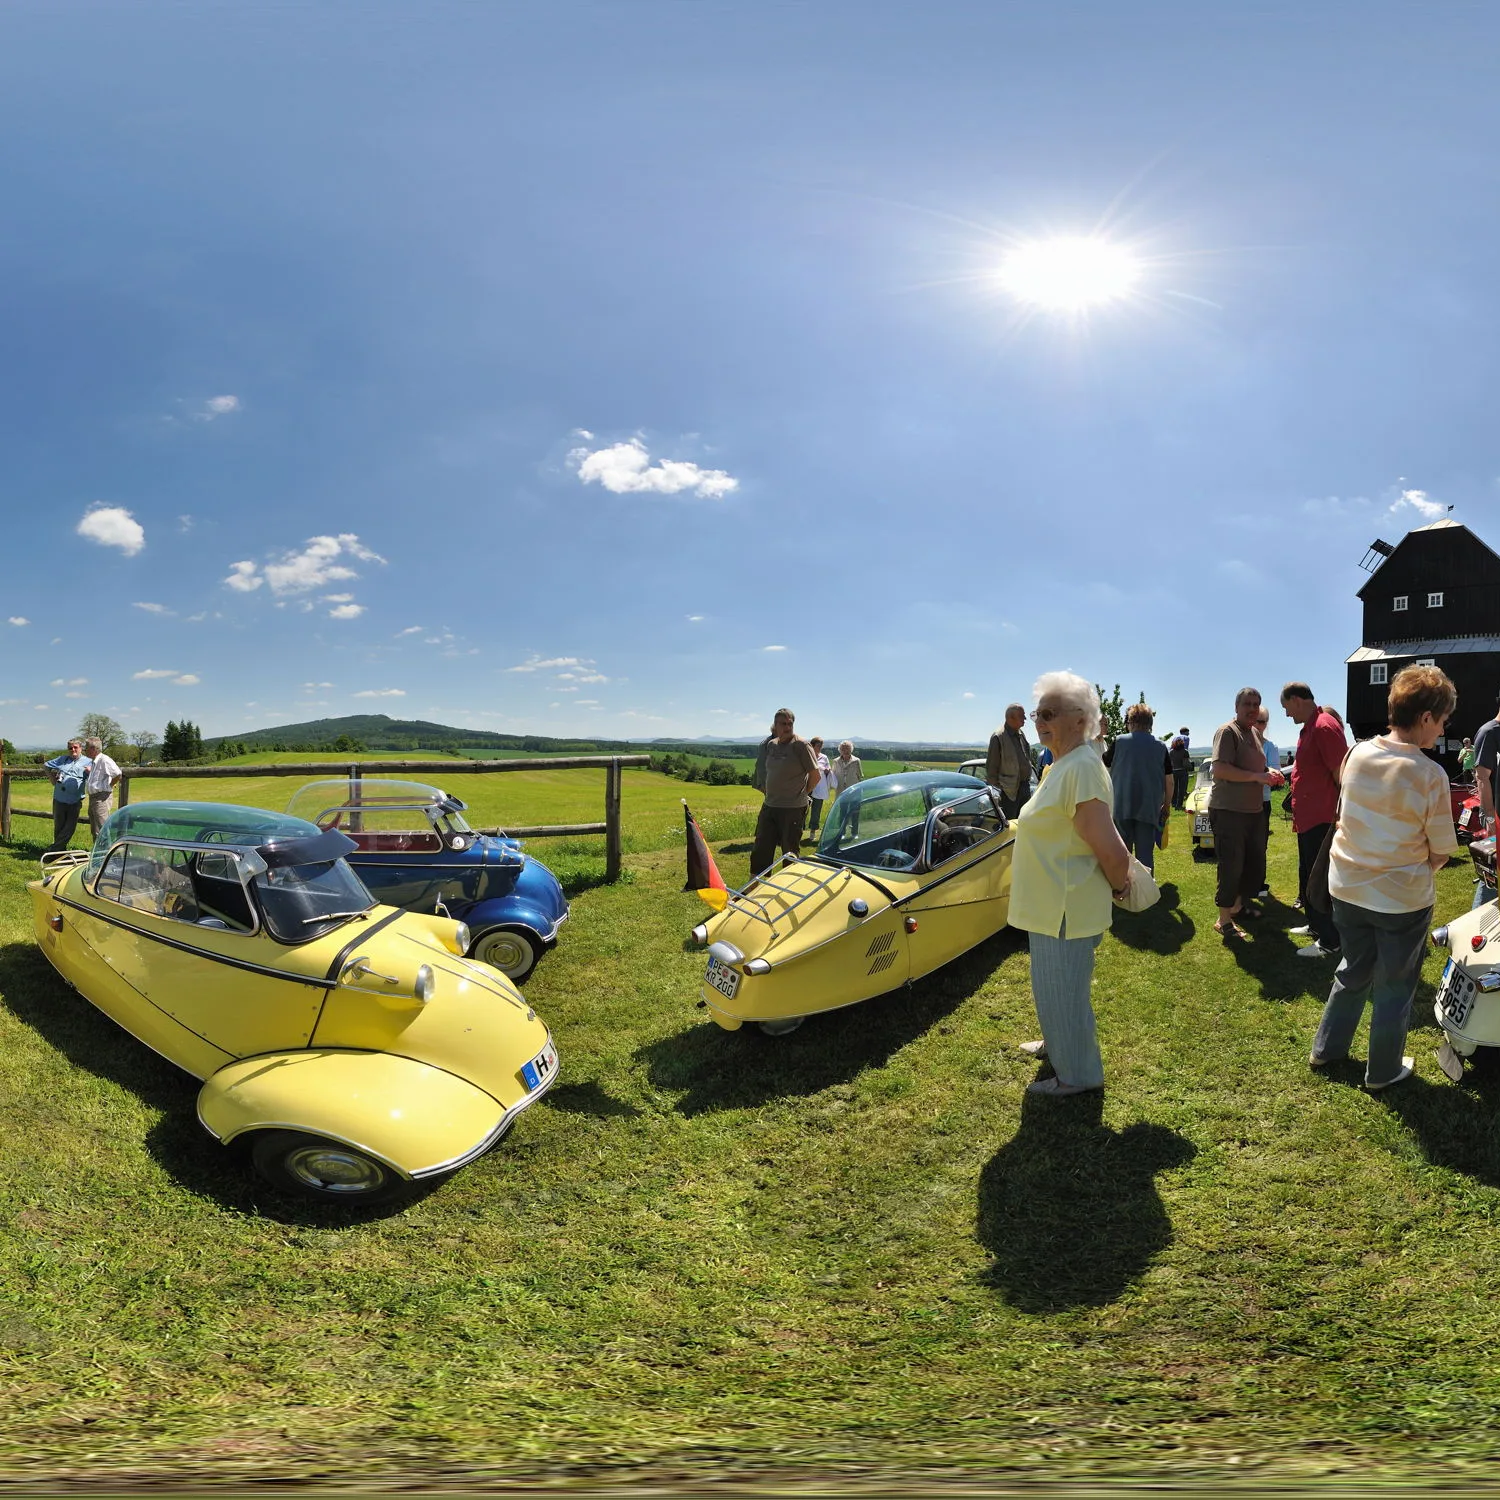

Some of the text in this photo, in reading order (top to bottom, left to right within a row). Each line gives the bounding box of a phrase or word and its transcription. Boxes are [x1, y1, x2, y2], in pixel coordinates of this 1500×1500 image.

[713, 960, 724, 976] PE
[716, 978, 734, 997] 200
[1449, 968, 1465, 996] HG
[1440, 987, 1467, 1024] 1955
[535, 1054, 549, 1078] H
